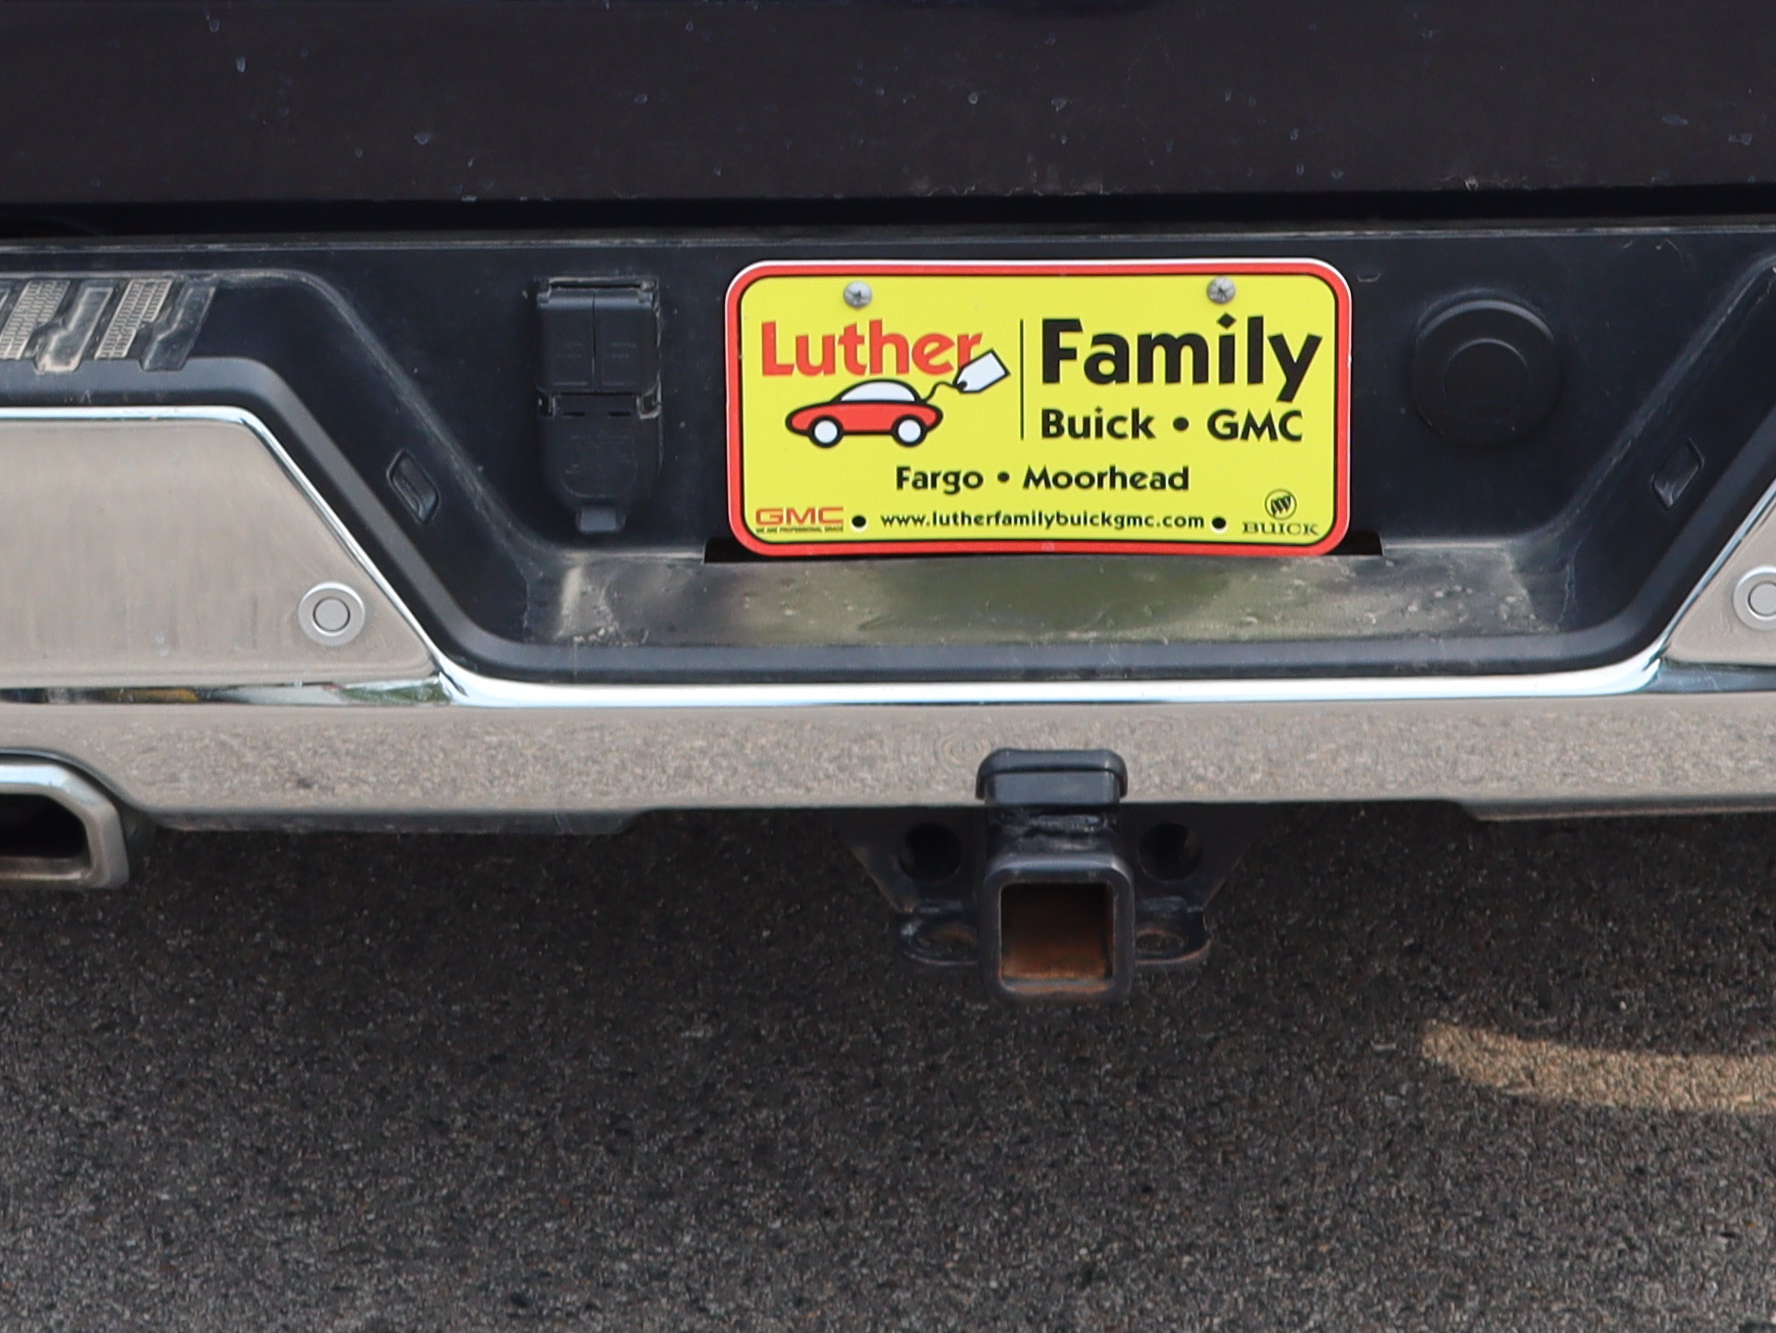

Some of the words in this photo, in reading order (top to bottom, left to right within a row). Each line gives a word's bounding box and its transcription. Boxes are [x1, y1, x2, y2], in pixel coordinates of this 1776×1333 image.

[762, 318, 983, 376] Luther
[1042, 312, 1323, 403] Family
[1041, 406, 1156, 439] Buick
[1207, 409, 1303, 442] GMC
[896, 465, 984, 495] Fargo
[1023, 464, 1190, 491] Moorhead
[756, 506, 844, 526] GMC
[881, 510, 1205, 529] www.lutherfamilybuickgmc.com
[1242, 521, 1320, 536] BUICK
